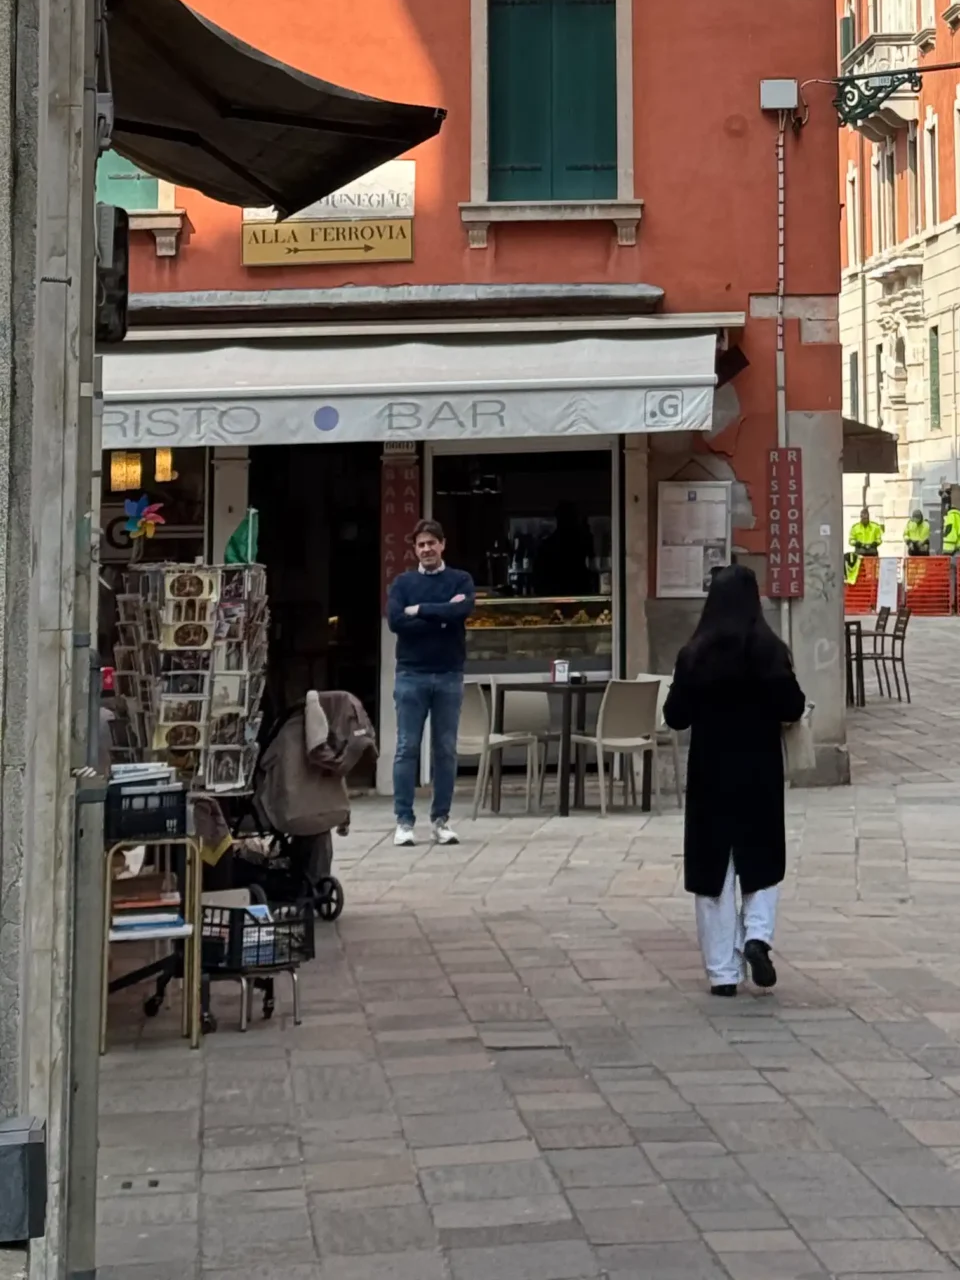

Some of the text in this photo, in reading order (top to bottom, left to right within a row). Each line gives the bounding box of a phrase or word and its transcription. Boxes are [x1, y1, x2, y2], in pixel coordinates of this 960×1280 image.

[248, 224, 407, 244] ALLA FERROVIA
[102, 400, 506, 438] RISTO BAR
[404, 470, 416, 514] BAR
[769, 451, 781, 593] RISTORANTE
[787, 450, 800, 594] RISTORANTE
